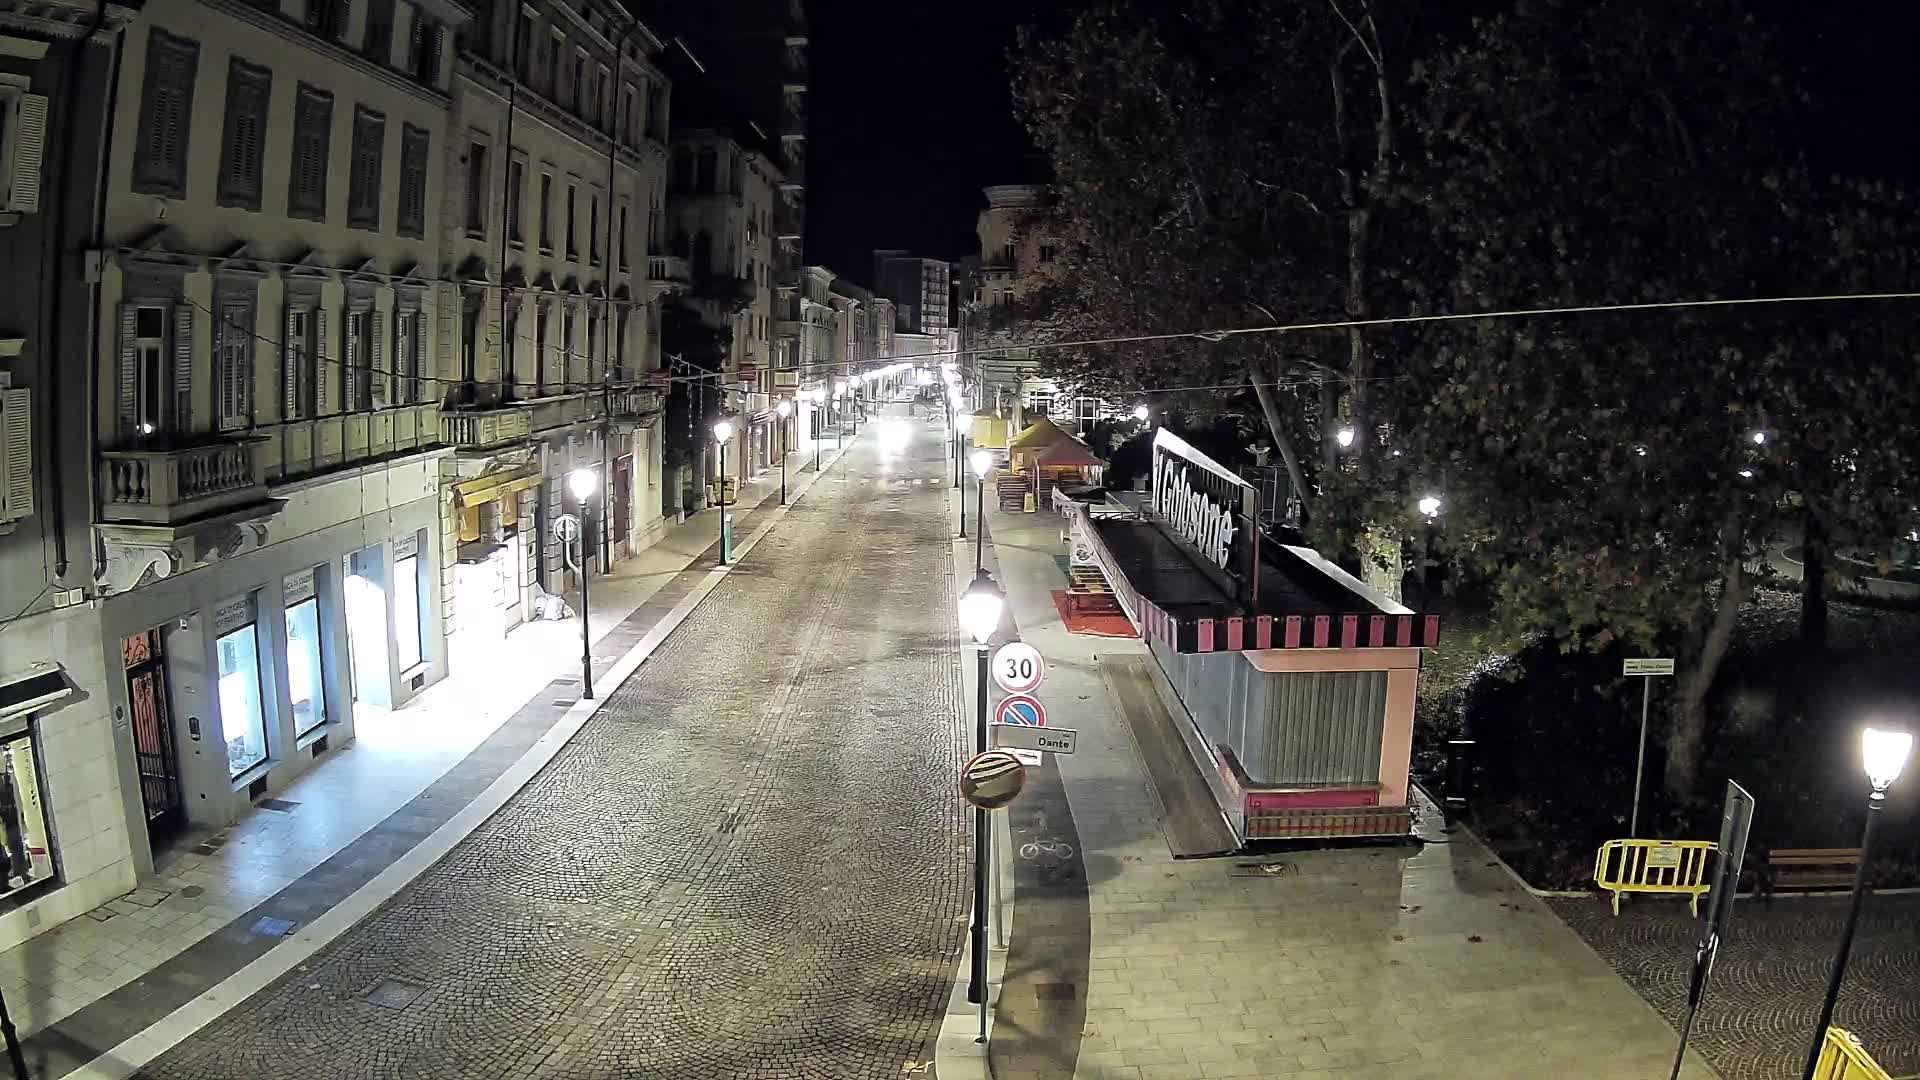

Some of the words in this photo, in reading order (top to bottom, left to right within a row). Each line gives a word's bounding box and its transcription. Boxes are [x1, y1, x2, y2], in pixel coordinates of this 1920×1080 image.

[1162, 458, 1233, 569] Golosone
[1006, 658, 1032, 679] 30
[1038, 737, 1070, 749] Dante
